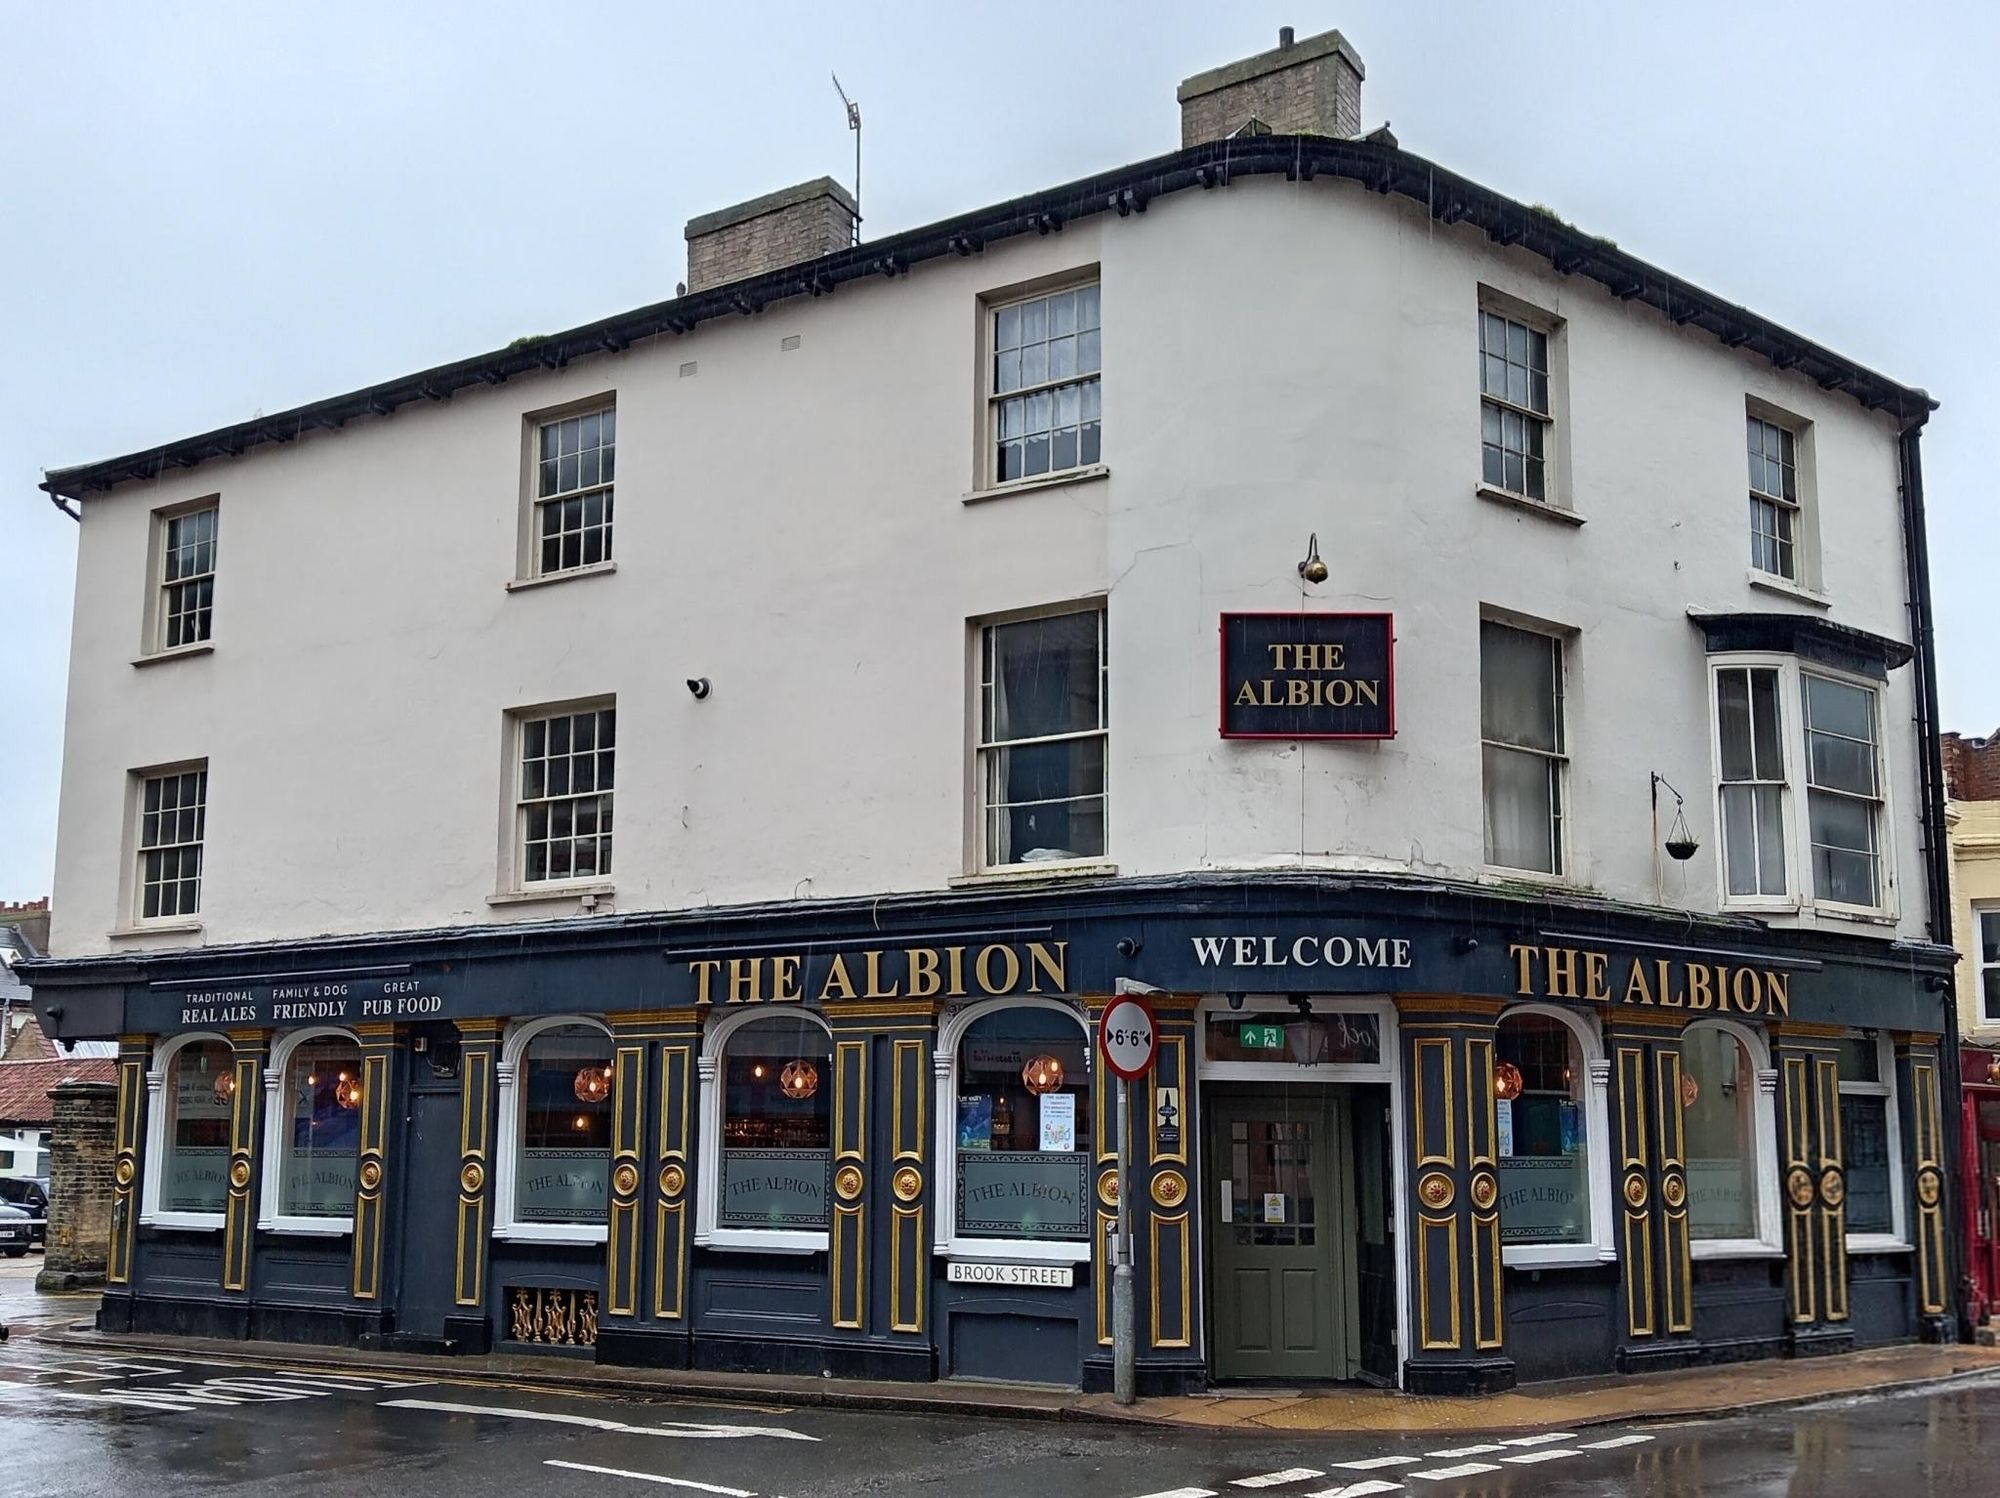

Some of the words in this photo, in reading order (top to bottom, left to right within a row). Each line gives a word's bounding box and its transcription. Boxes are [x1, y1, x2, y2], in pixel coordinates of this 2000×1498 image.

[1268, 644, 1345, 670] THE
[1233, 679, 1380, 706] ALBION
[1191, 936, 1412, 969] WELCOME
[688, 954, 801, 1005] THE
[818, 941, 1068, 1000] ALBION
[1510, 944, 1611, 1001] THE
[1623, 957, 1790, 1017] ALBION
[186, 990, 254, 1003] TRADITIONAL
[273, 986, 310, 999] FAMILY
[313, 987, 320, 997] &
[324, 984, 348, 997] DOG
[383, 981, 420, 993] GREAT
[181, 1008, 217, 1024] REAL
[220, 1005, 256, 1022] ALES
[273, 1001, 347, 1019] FRIENDLY
[362, 998, 393, 1016] PUB
[397, 996, 442, 1013] FOOD
[525, 1174, 554, 1192] THE
[729, 1177, 761, 1196] THE
[765, 1176, 821, 1200] ALBION
[968, 1183, 1005, 1203] THE
[1009, 1182, 1076, 1206] ALBION
[1499, 1188, 1529, 1209] THE
[954, 1265, 1005, 1281] BROOK
[1011, 1267, 1067, 1285] STREET
[54, 1371, 439, 1411] TURN
